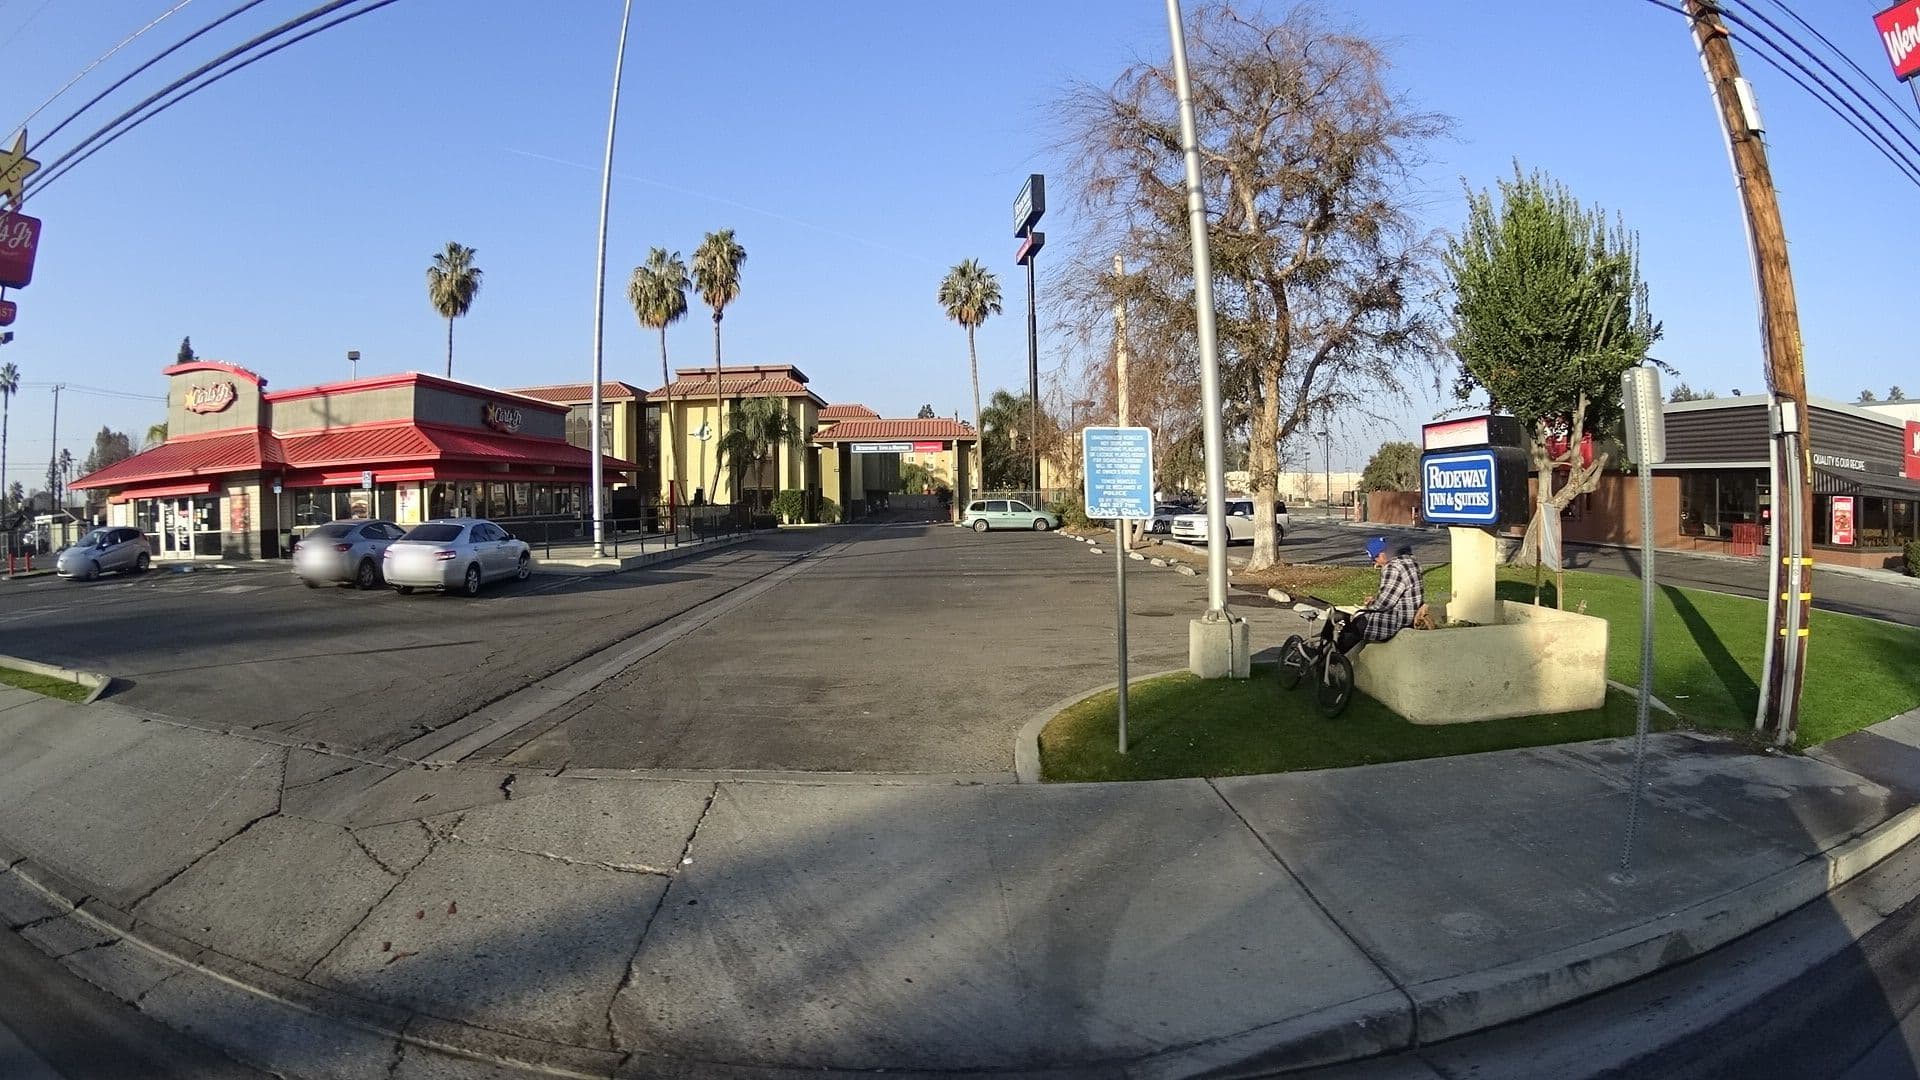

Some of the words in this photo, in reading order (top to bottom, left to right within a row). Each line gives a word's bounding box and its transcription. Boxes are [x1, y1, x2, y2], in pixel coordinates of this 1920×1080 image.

[1813, 454, 1834, 465] QUALITY
[1840, 458, 1849, 468] OUR
[1850, 459, 1865, 470] RECIPE
[1429, 466, 1488, 489] RODEWAY
[1429, 492, 1446, 510] INN
[1447, 492, 1454, 506] &
[1454, 492, 1489, 512] SUITES
